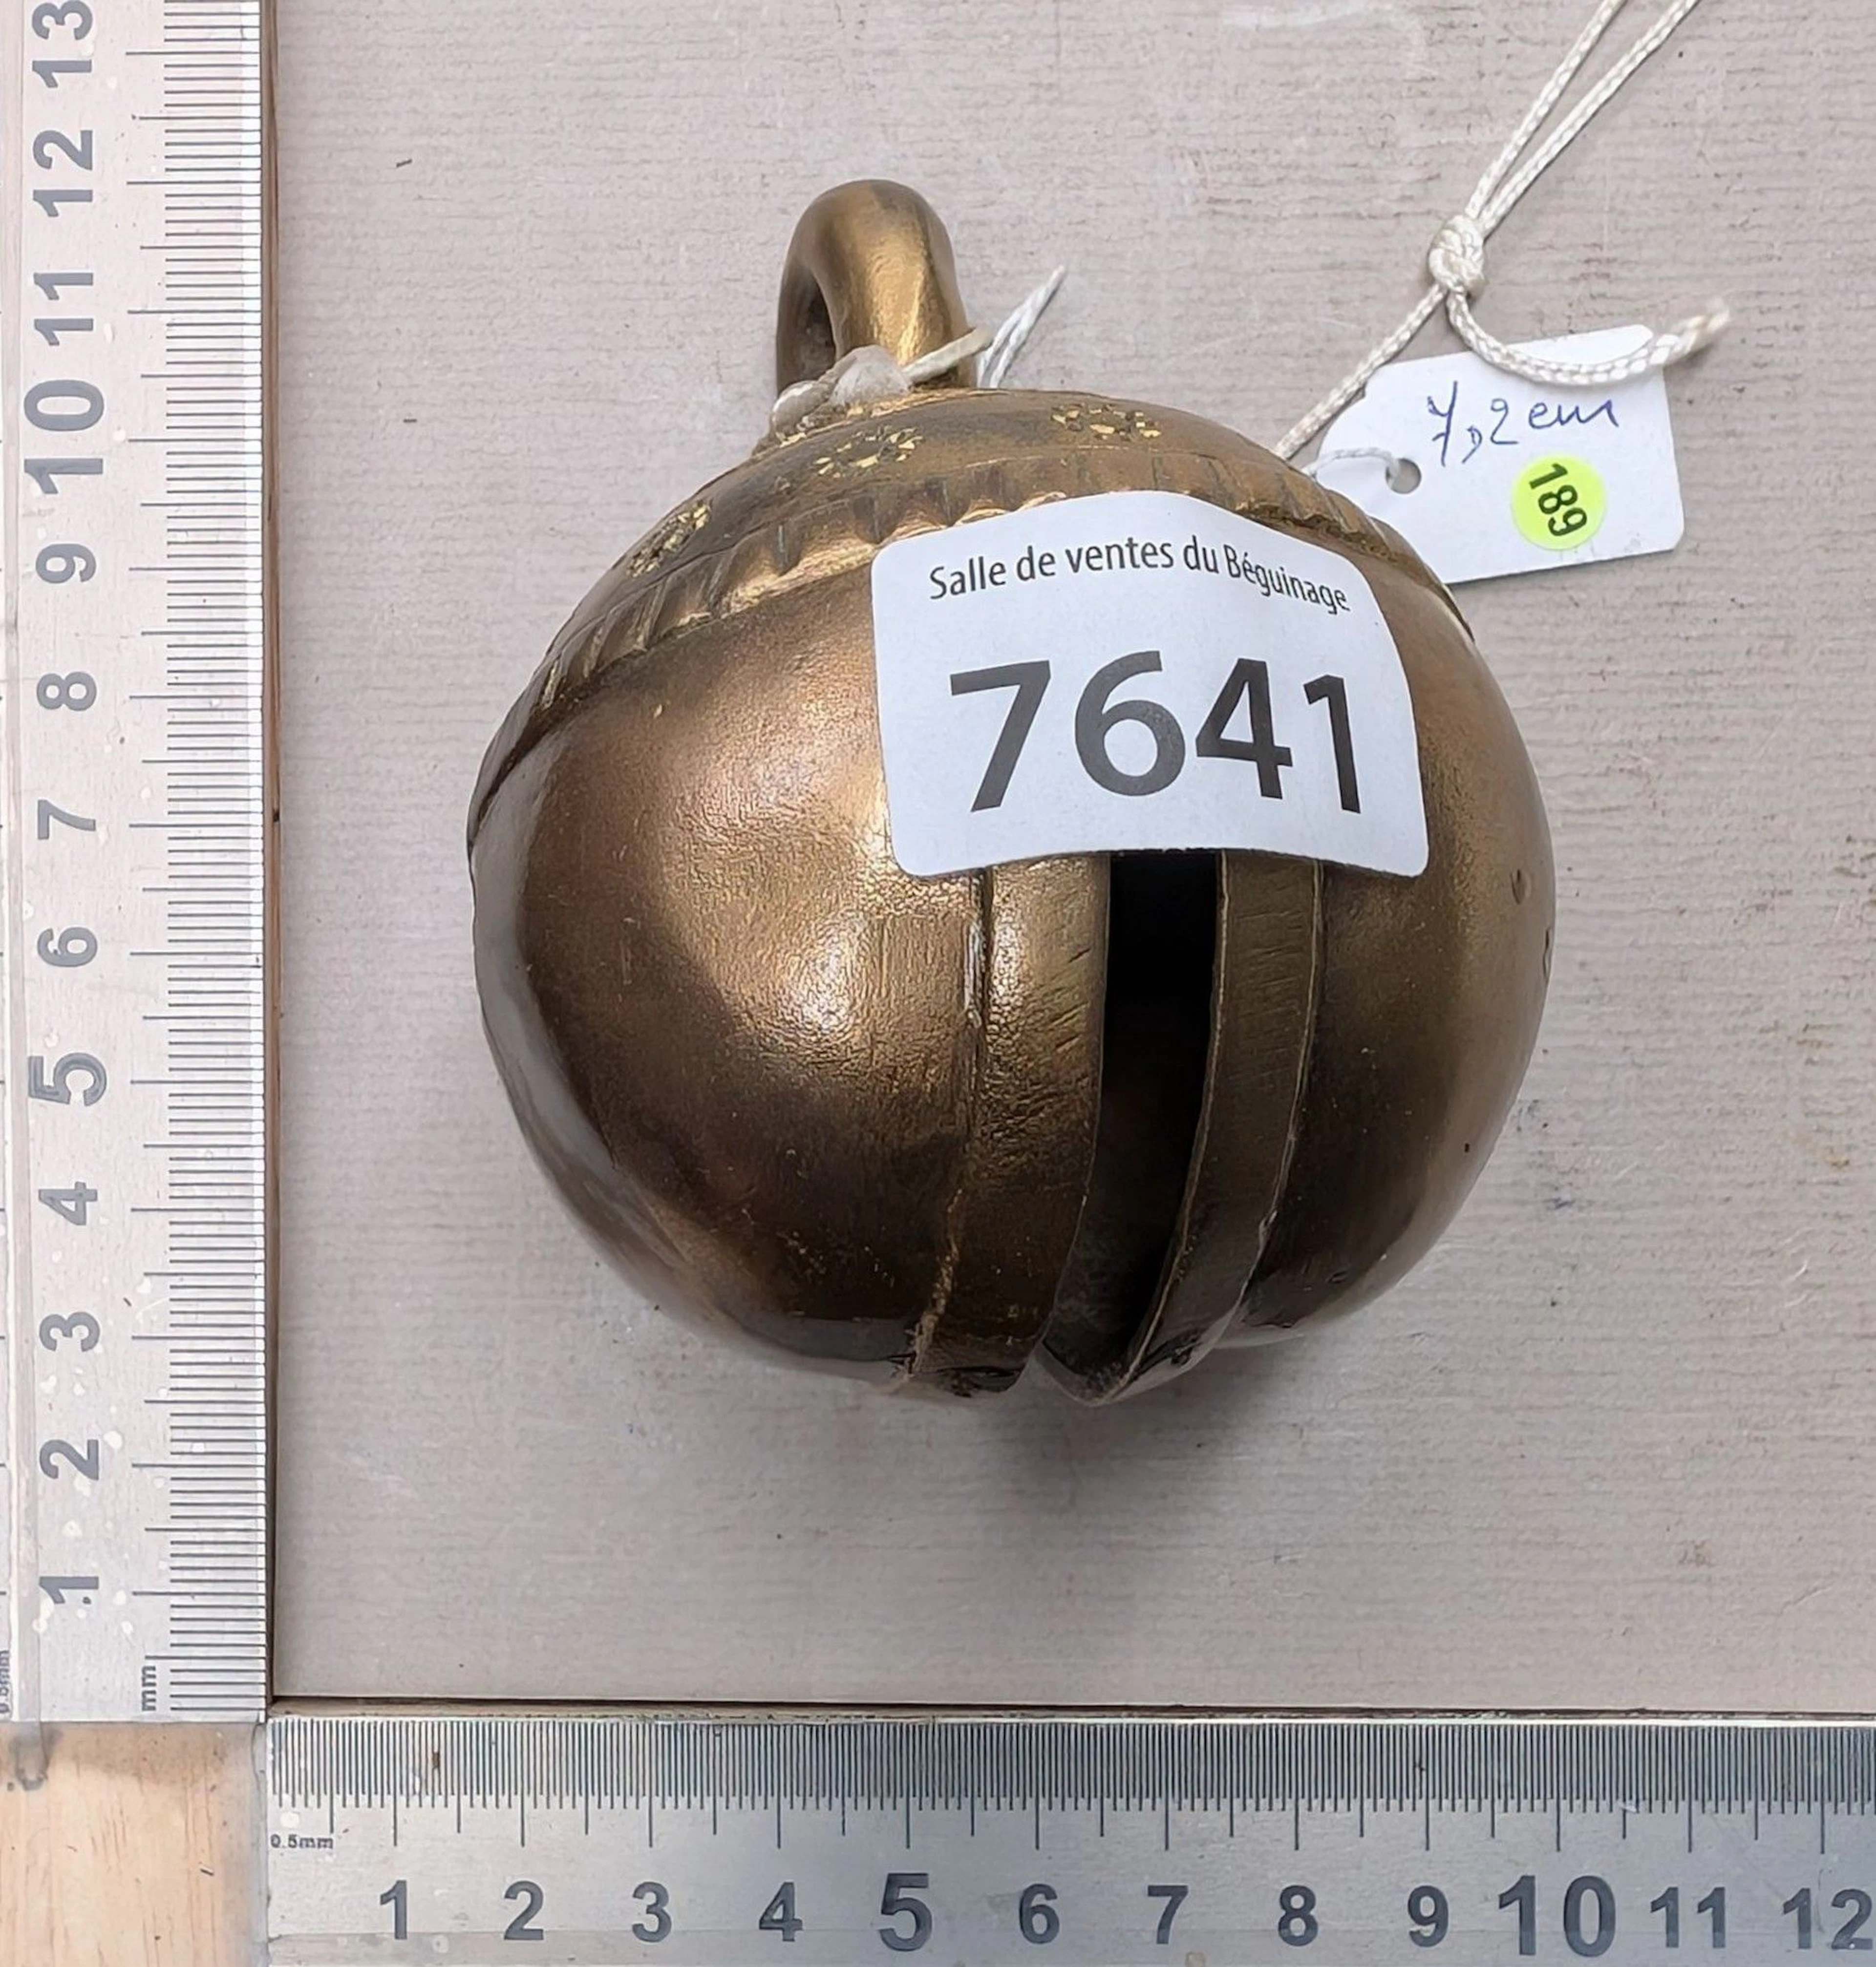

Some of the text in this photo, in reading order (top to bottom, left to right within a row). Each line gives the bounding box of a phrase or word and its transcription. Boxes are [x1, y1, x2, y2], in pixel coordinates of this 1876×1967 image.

[1529, 463, 1587, 536] 189
[930, 535, 1351, 615] Salle de ventes du Béguinage
[950, 651, 1361, 814] 7641
[24, 0, 107, 1604] 1 2 3 4 5 6 7 8 9 10 11 12 13
[142, 1666, 157, 1712] mm
[270, 1834, 334, 1849] 0.5mm
[380, 1873, 1872, 1956] 1 2 3 4 5 6 7 8 9 10 11 12
